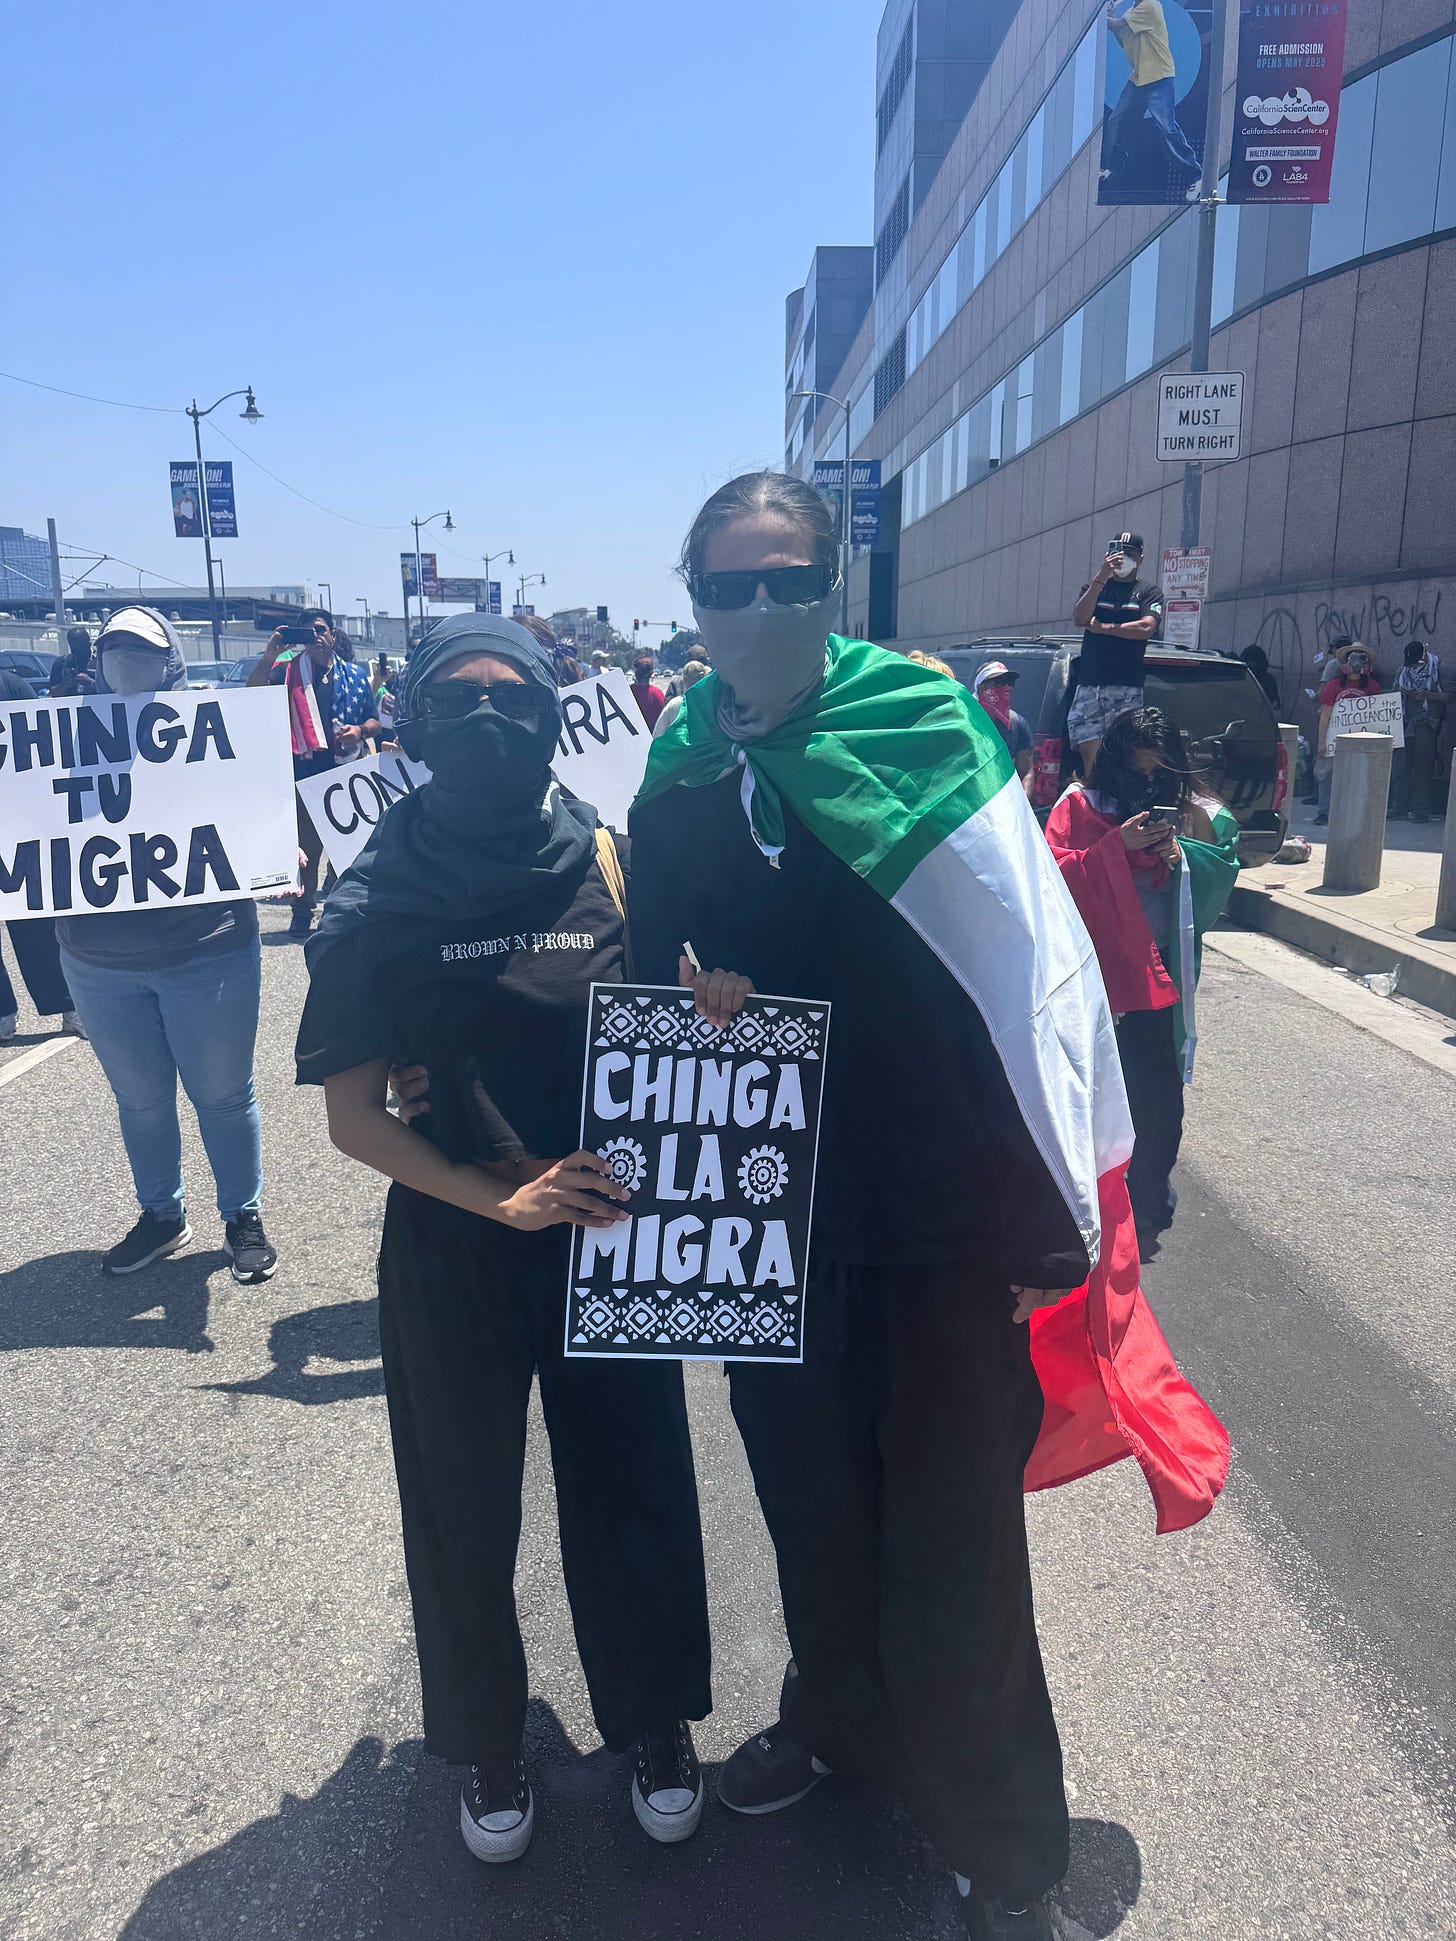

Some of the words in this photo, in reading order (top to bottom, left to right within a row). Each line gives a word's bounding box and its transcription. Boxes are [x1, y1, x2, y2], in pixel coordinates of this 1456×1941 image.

[1259, 44, 1278, 56] FREE
[1278, 43, 1324, 55] ADMISSION
[1256, 58, 1282, 69] OPENS
[1285, 57, 1303, 68] MAY
[1305, 56, 1326, 67] 2025
[1241, 126, 1329, 136] CaliforniaScienceCenter.org
[1249, 149, 1269, 158] WALTER
[1269, 148, 1287, 157] FAMILY
[1286, 148, 1318, 157] FOUNDATION
[1165, 385, 1201, 399] RIGHT
[1204, 384, 1237, 398] LANE
[1178, 408, 1221, 426] MUST
[1163, 436, 1195, 450] TURN
[1198, 435, 1235, 449] RIGHT
[170, 468, 199, 482] GAME
[206, 468, 223, 482] ON!
[815, 468, 844, 483] GAME
[851, 468, 871, 483] ON!
[1163, 558, 1178, 572] NO
[1178, 558, 1209, 569] STOPPING
[1167, 574, 1182, 583] ANY
[1338, 697, 1377, 713] STOP
[559, 683, 639, 757] RA
[0, 701, 236, 773] HINGA
[52, 773, 132, 824] TU
[0, 824, 241, 912] MIGRA
[440, 937, 511, 962] BROWN
[514, 933, 528, 950] N
[531, 932, 595, 953] PROUD
[593, 1051, 806, 1131] CHINGA
[656, 1133, 725, 1202] LA
[579, 1213, 796, 1288] MIGRA
